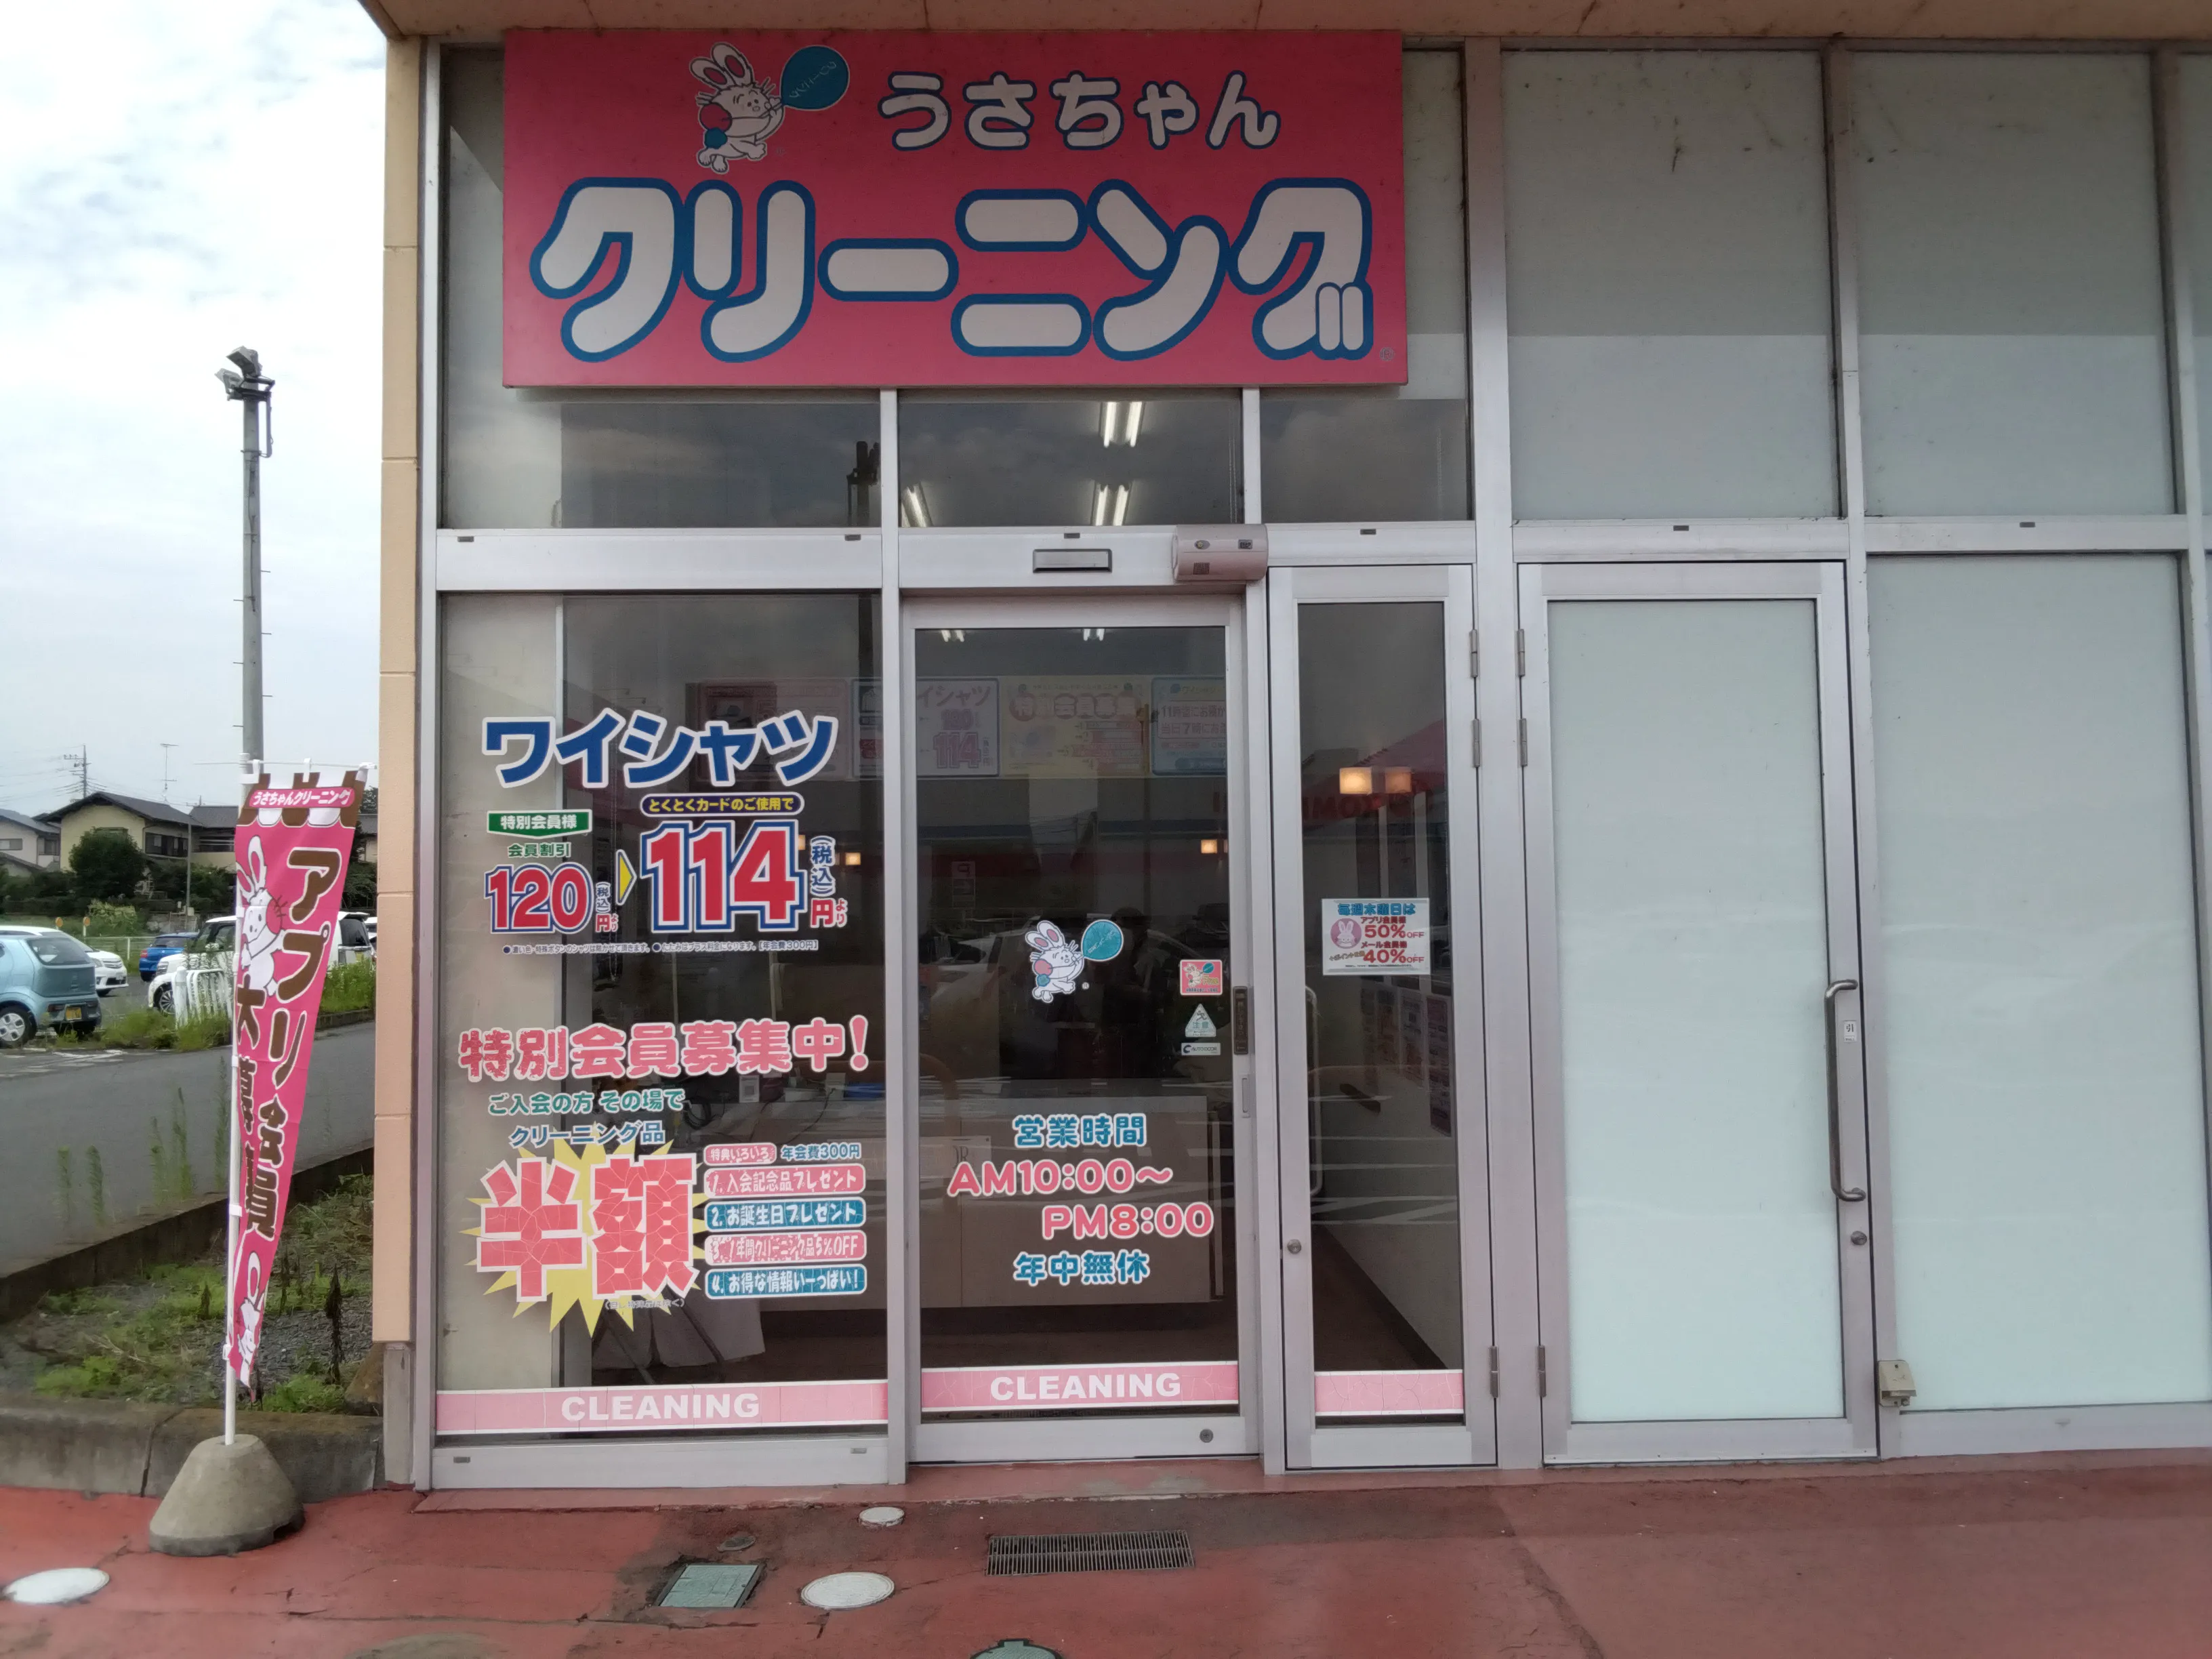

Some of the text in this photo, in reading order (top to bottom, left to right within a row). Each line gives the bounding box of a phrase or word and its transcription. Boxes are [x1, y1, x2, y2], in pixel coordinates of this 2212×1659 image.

[876, 70, 1282, 150] うさちゃん
[529, 177, 1374, 363] クリーニング
[482, 708, 838, 788] ワイシャツ
[253, 789, 352, 806] うさちゃんクリーニング
[649, 797, 794, 812] とくとくカードのご使用で
[500, 814, 577, 830] 特別会員様
[508, 842, 572, 859] 会員割引
[640, 819, 808, 933] 114
[484, 861, 594, 935] 120
[1337, 903, 1416, 916] 毎週木曜日は
[1364, 924, 1406, 939] 50%
[1363, 949, 1406, 963] 40%
[458, 1015, 869, 1082] 特別会員募集中!
[487, 1088, 687, 1116] ご入会の方 その場で
[508, 1120, 666, 1148] クリーニング品
[1012, 1113, 1147, 1148] 営業時間
[710, 1142, 861, 1162] 特典いろいろ 年会費300円
[476, 1153, 700, 1303] 半額
[1042, 1202, 1214, 1240] PM8:00
[1013, 1249, 1151, 1286] 年中無休
[990, 1372, 1181, 1401] CLEANING
[561, 1393, 760, 1422] CLEANING
